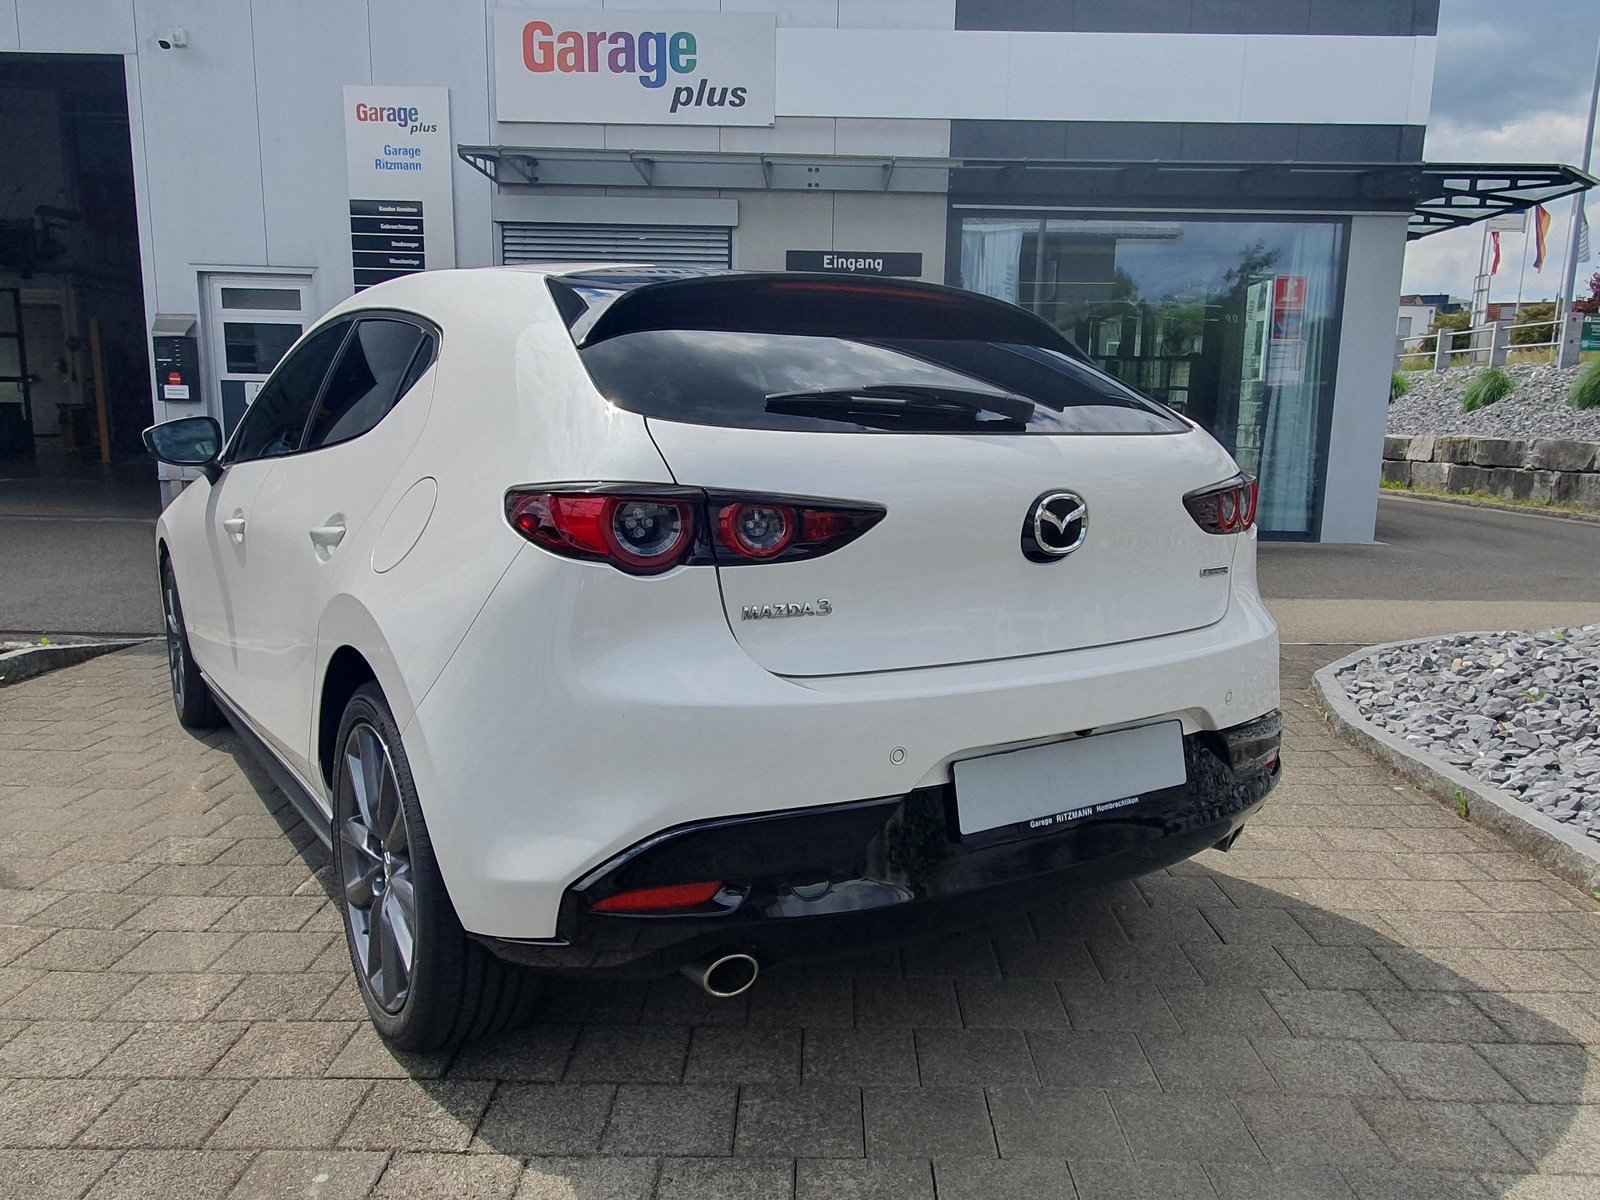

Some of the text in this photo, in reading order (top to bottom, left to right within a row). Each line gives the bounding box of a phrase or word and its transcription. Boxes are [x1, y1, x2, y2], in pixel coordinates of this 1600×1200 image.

[522, 21, 697, 88] Garage
[669, 79, 748, 113] plus
[356, 103, 419, 128] Garage
[410, 122, 438, 135] plus
[384, 144, 421, 158] Garage
[375, 159, 422, 171] Ritzmann
[823, 255, 883, 272] Eingang
[1029, 797, 1139, 829] Garage RITZMANN Hombrechtikon
